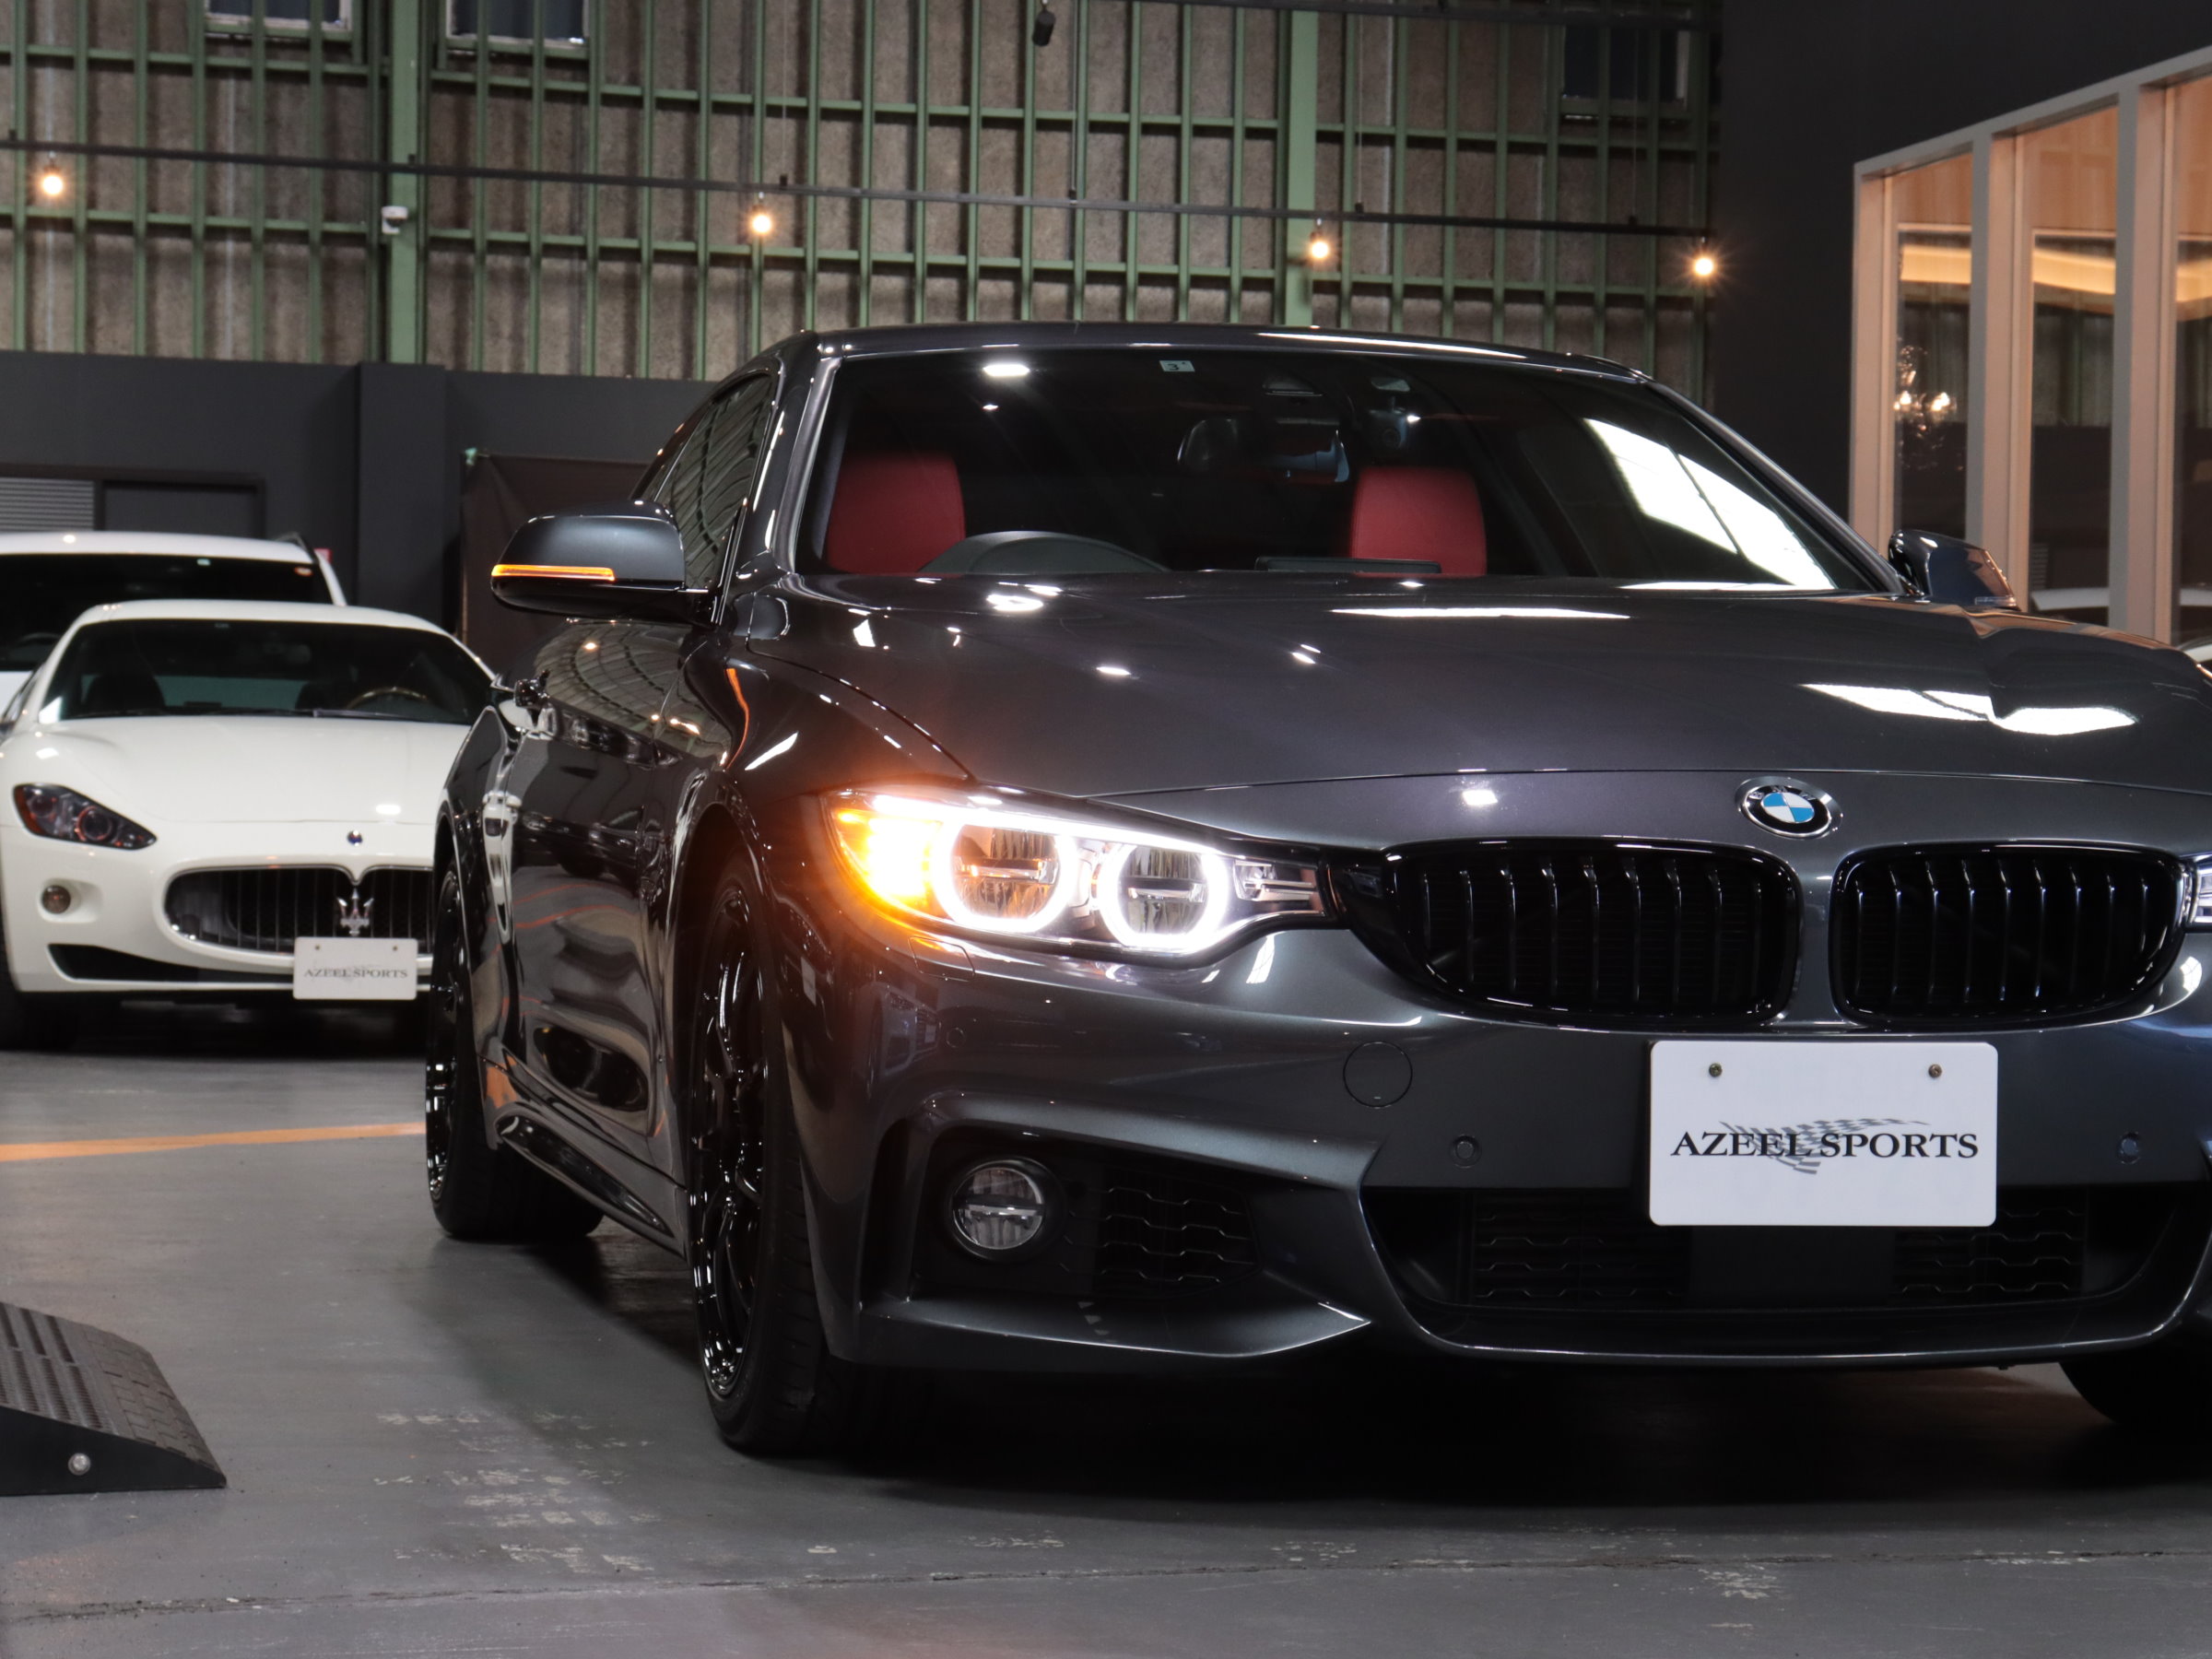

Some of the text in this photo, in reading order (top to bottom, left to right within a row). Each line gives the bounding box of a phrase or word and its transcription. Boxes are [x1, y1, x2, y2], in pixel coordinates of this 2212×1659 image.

[303, 969, 408, 979] AZEEL SPORTS
[1671, 1131, 1979, 1159] AZEEL SPORTS
